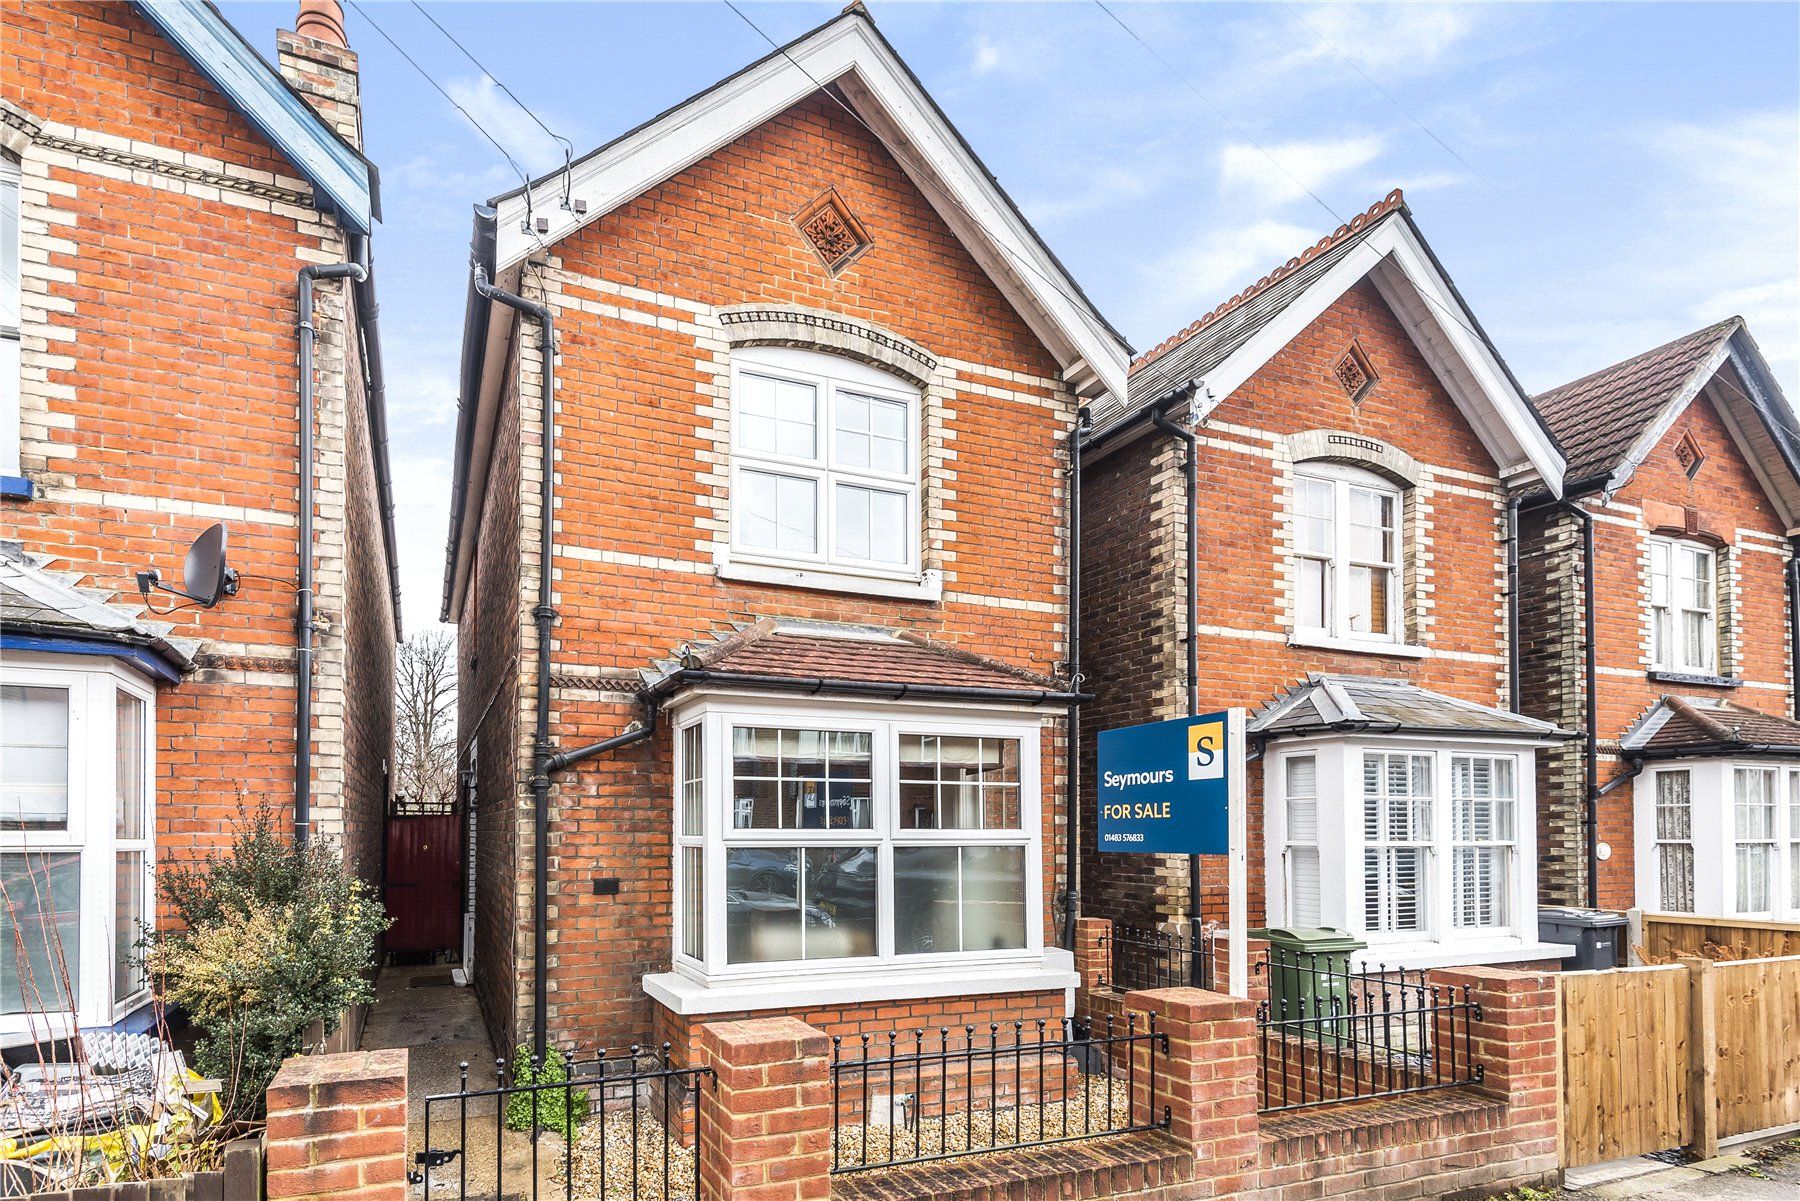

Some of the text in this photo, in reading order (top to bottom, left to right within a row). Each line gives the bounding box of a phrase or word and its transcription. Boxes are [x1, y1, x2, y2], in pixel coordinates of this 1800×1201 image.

[1196, 736, 1214, 767] S
[1104, 770, 1173, 790] Seymours
[1104, 802, 1171, 820] FOR SALE
[1104, 833, 1145, 842] 01483 576833
